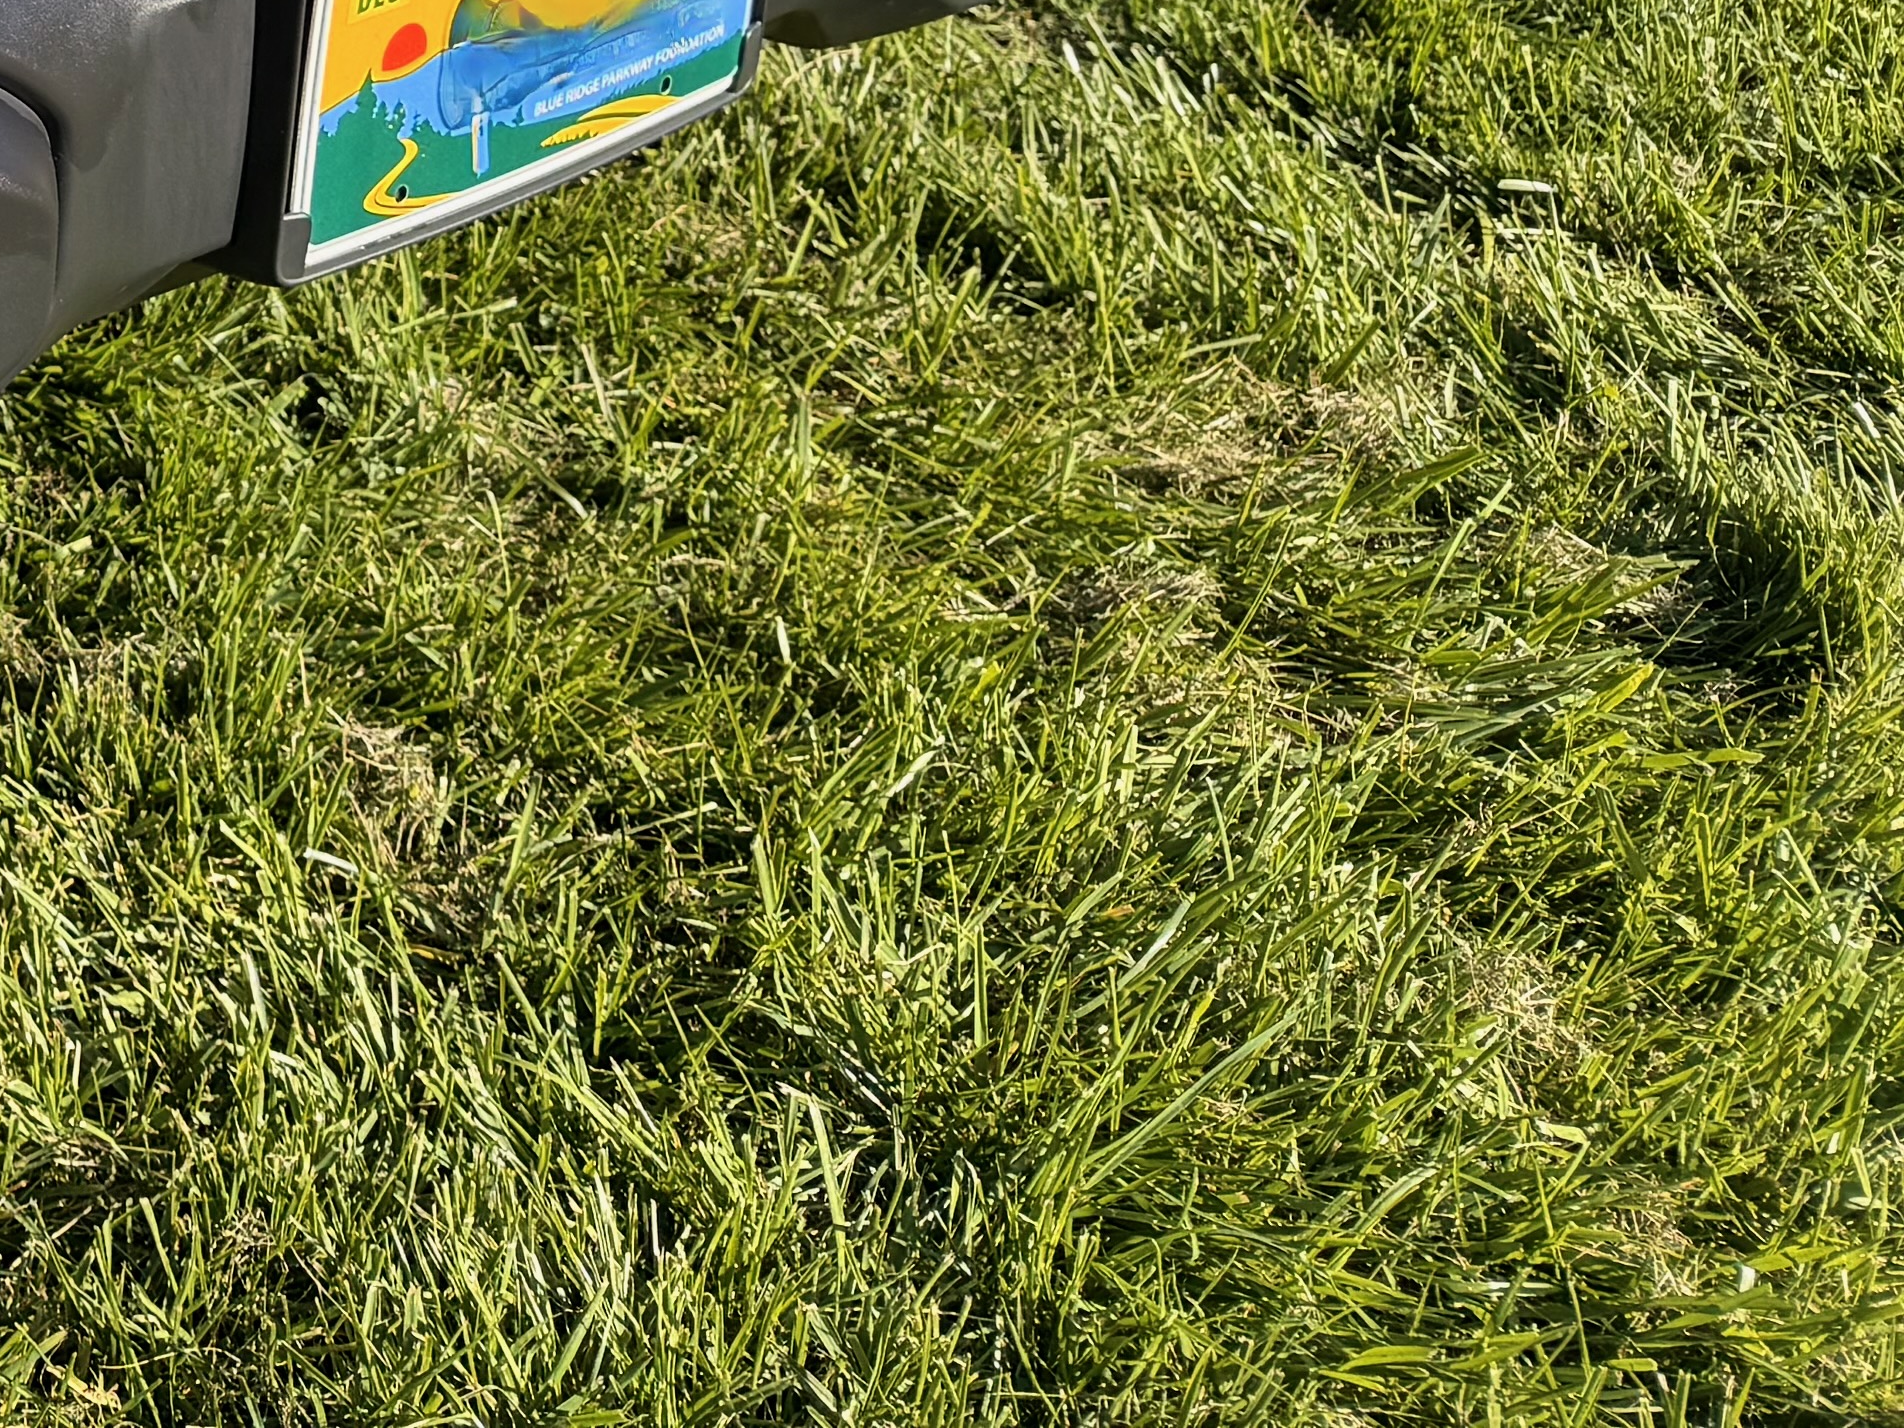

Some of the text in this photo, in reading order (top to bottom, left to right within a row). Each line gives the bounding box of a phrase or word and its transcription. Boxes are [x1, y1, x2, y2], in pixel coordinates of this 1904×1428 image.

[533, 91, 565, 118] BLUE
[565, 77, 601, 105] RIDGE
[601, 54, 654, 89] PARKWAY
